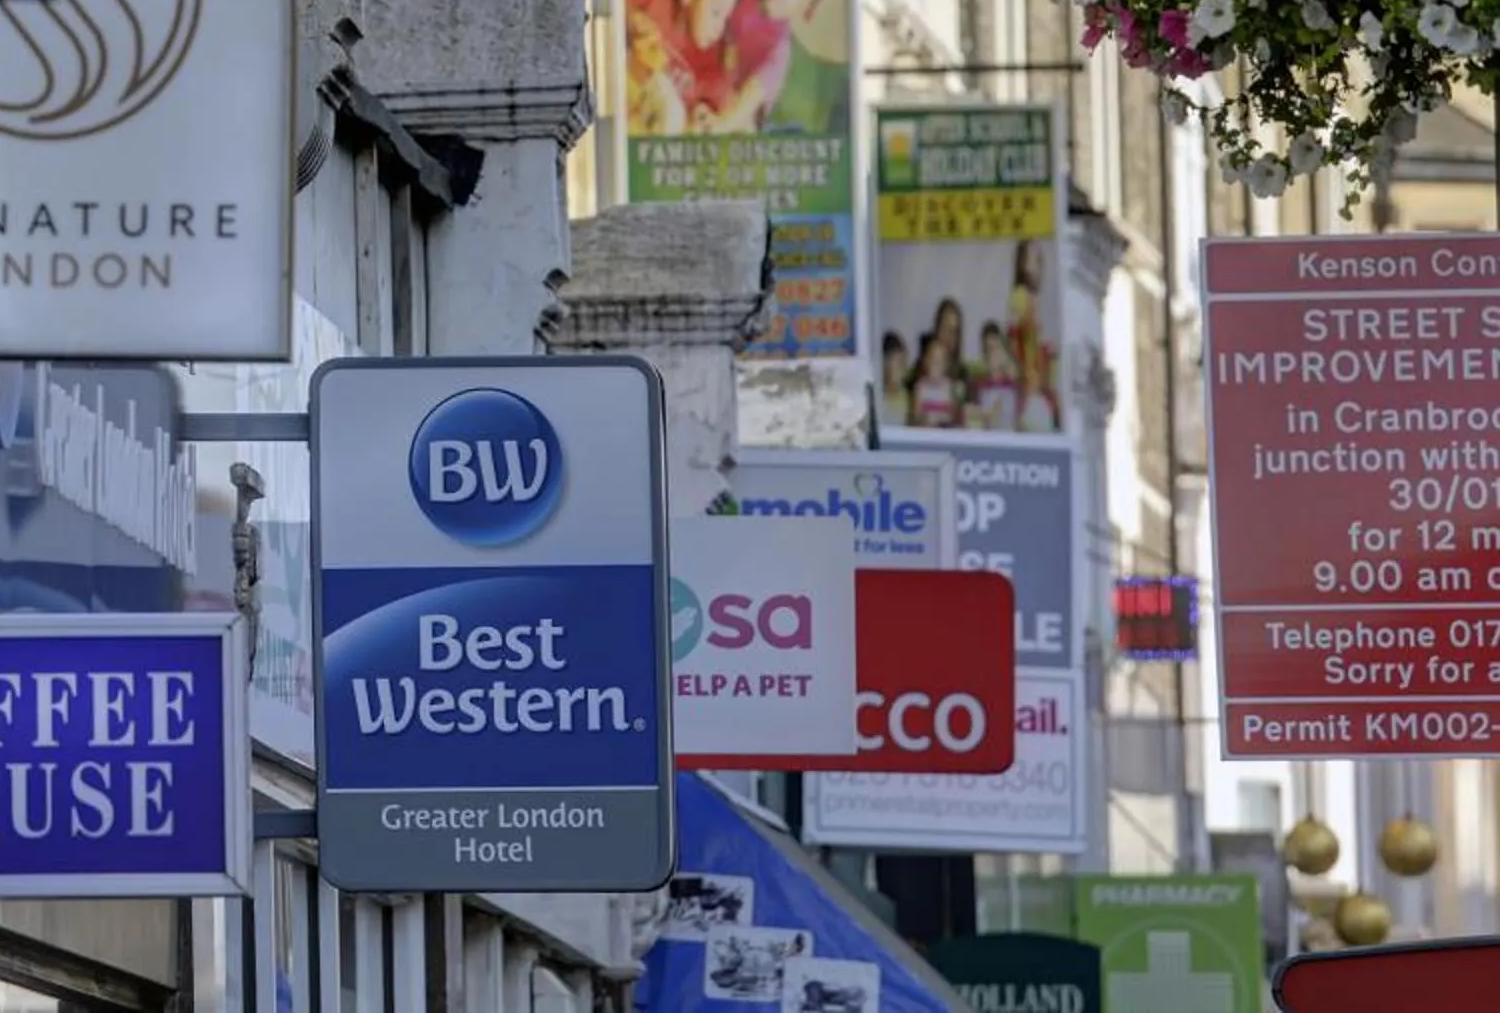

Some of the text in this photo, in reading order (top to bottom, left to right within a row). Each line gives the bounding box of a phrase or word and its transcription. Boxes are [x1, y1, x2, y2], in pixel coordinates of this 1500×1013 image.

[638, 138, 842, 164] FAMILY DISCOUNT
[654, 166, 696, 187] FOR
[727, 165, 752, 186] OR
[766, 164, 829, 186] MORE
[1299, 249, 1500, 279] Kenson Con
[1303, 305, 1500, 341] STREET S
[1287, 403, 1319, 434] in
[429, 438, 548, 504] BW
[957, 460, 1060, 487] OCATION
[1254, 440, 1500, 480] junction with
[956, 490, 1007, 532] OP
[864, 539, 887, 554] for
[890, 538, 925, 554] less
[1348, 520, 1402, 552] for
[1418, 520, 1456, 551] 12
[1313, 560, 1403, 593] 9.00
[1417, 567, 1472, 591] am
[707, 593, 813, 650] sa
[1015, 610, 1064, 653] LE
[1265, 619, 1500, 653] Telephone 017
[419, 614, 566, 671] Best
[678, 674, 813, 697] ELP A PET
[1325, 656, 1414, 689] Sorry
[1427, 655, 1475, 683] for
[353, 679, 630, 735] Western
[856, 691, 988, 753] CCO
[1016, 698, 1069, 735] ail.
[1244, 714, 1353, 743] Permit
[381, 803, 604, 831] Greater London
[455, 837, 533, 863] Hotel
